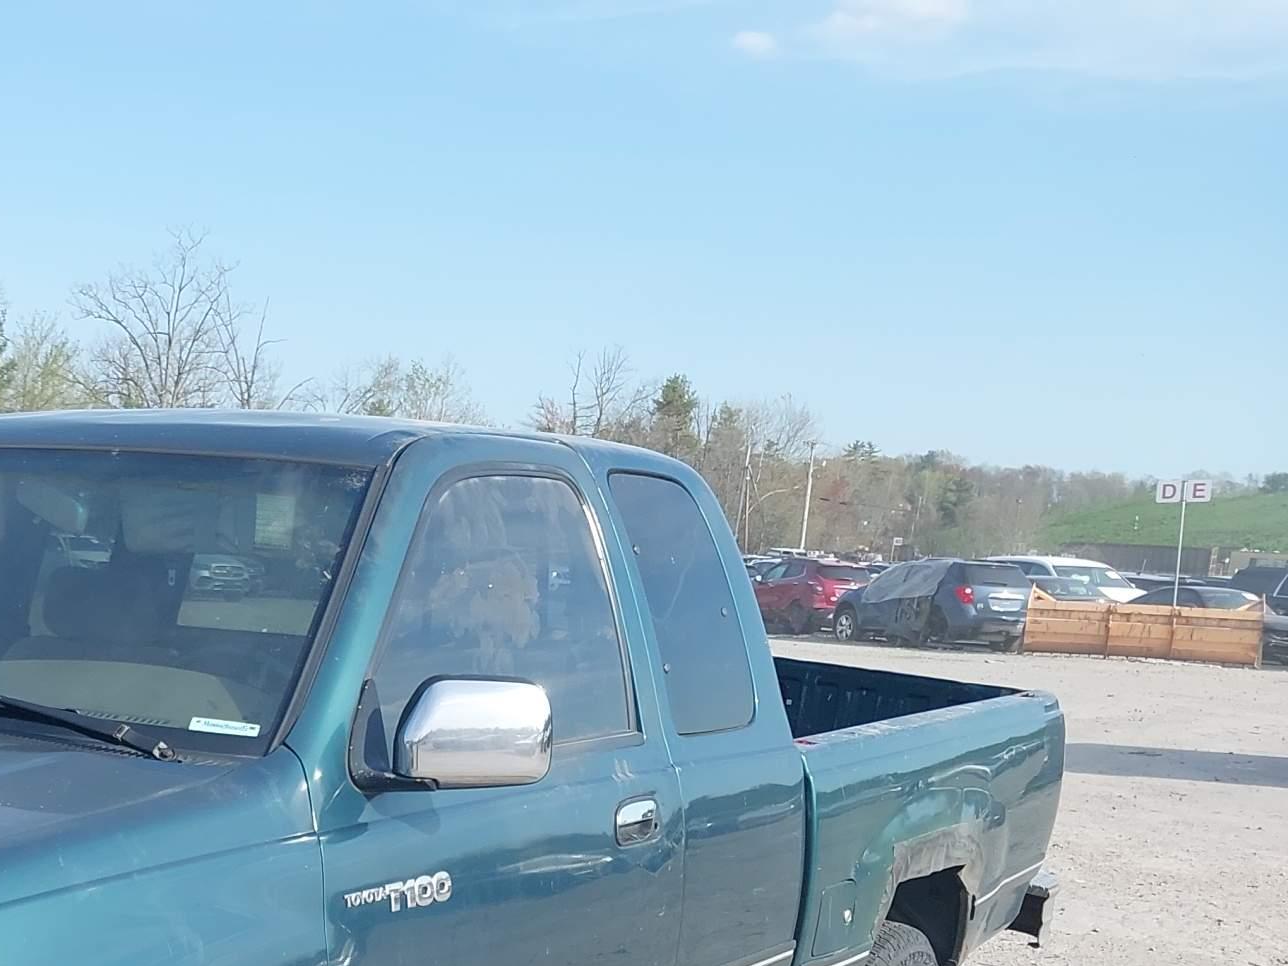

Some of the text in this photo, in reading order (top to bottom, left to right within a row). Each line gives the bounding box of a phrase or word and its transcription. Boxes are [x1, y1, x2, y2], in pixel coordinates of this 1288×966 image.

[1161, 483, 1177, 500] D
[1192, 482, 1207, 499] E
[384, 870, 453, 913] T100
